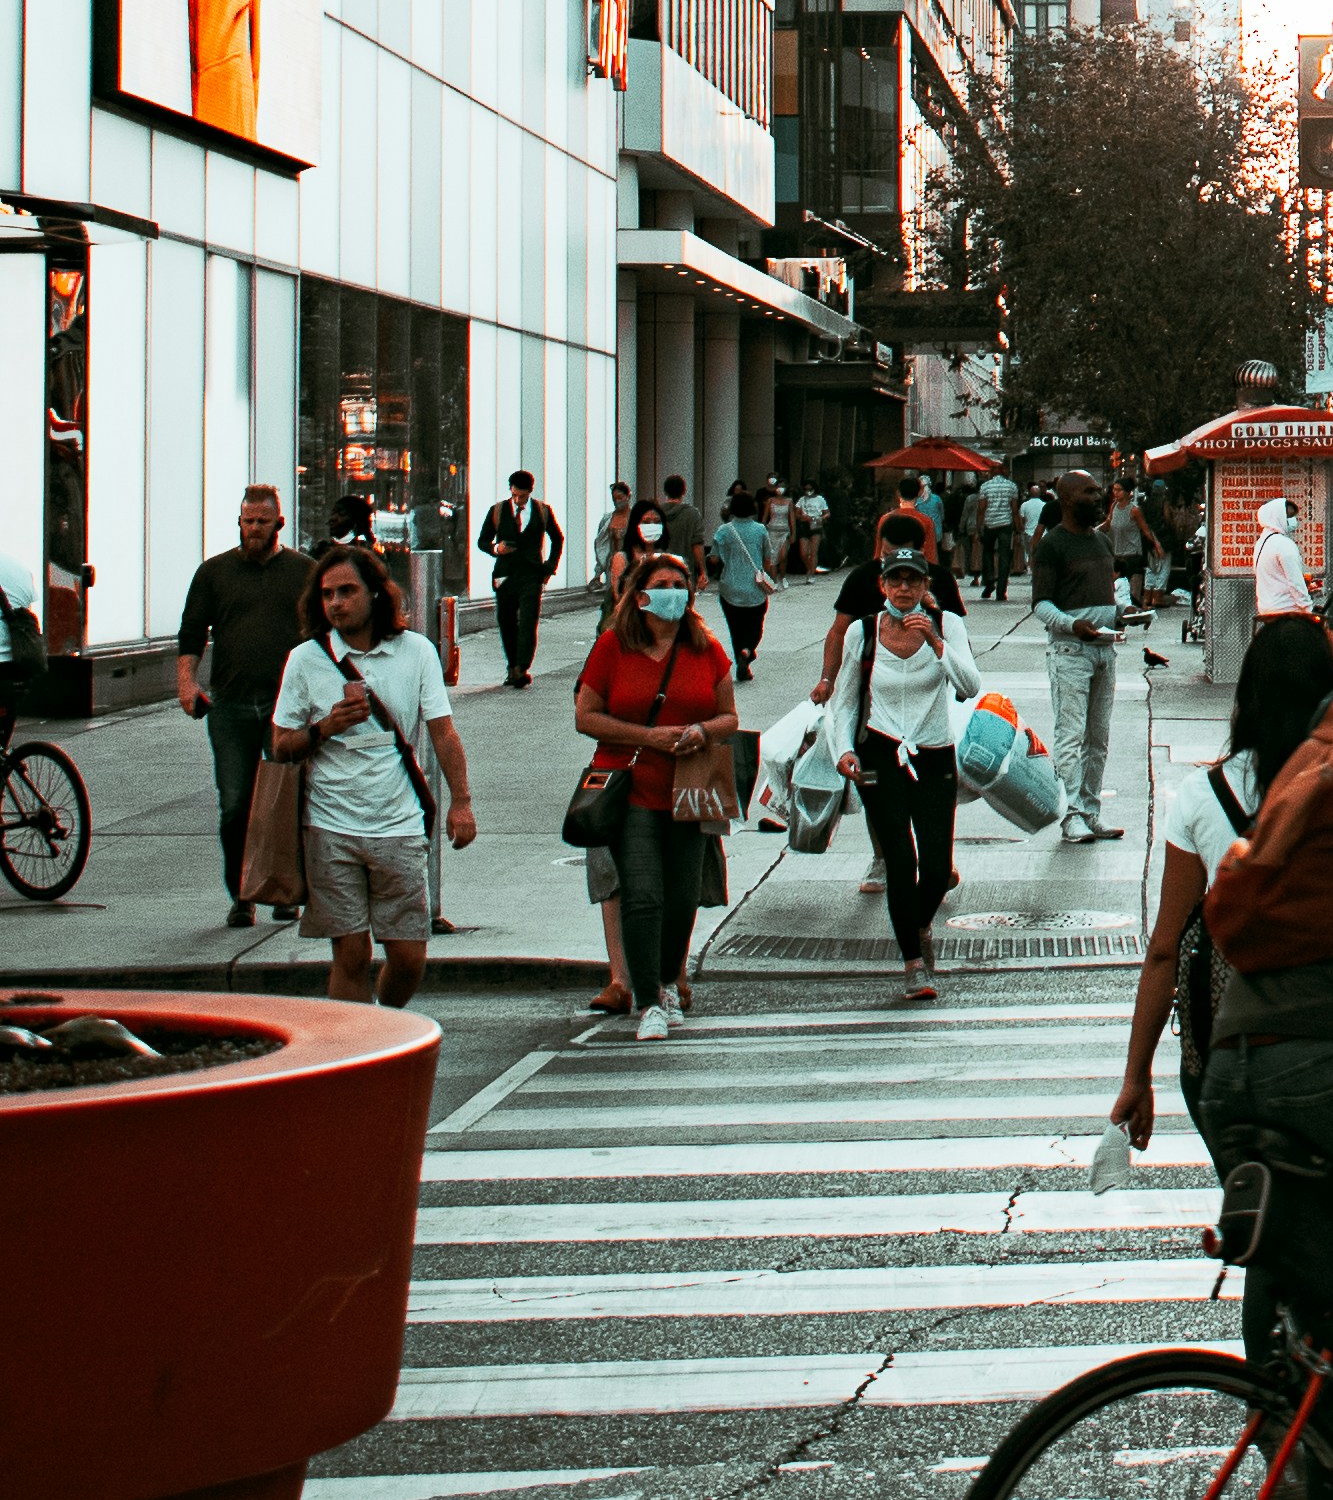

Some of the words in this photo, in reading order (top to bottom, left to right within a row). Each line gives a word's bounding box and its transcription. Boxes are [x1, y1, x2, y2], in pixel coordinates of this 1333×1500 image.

[1234, 425, 1279, 438] COLD
[1029, 436, 1049, 447] BC
[1052, 435, 1084, 448] Royal
[1203, 438, 1239, 449] HOT
[1243, 438, 1292, 449] DOGS
[1221, 465, 1248, 475] POLISH
[1249, 465, 1283, 475] SAUSAGE
[1221, 477, 1249, 487] ITALIAN
[1249, 477, 1283, 487] SAUSAGE
[1221, 489, 1253, 498] CHICKEN
[1221, 523, 1233, 533] ICE
[1236, 523, 1254, 533] COLD
[1221, 535, 1233, 544] ICE
[1236, 535, 1254, 544] COLD
[1221, 547, 1241, 556] COLD
[673, 788, 724, 817] ZARA
